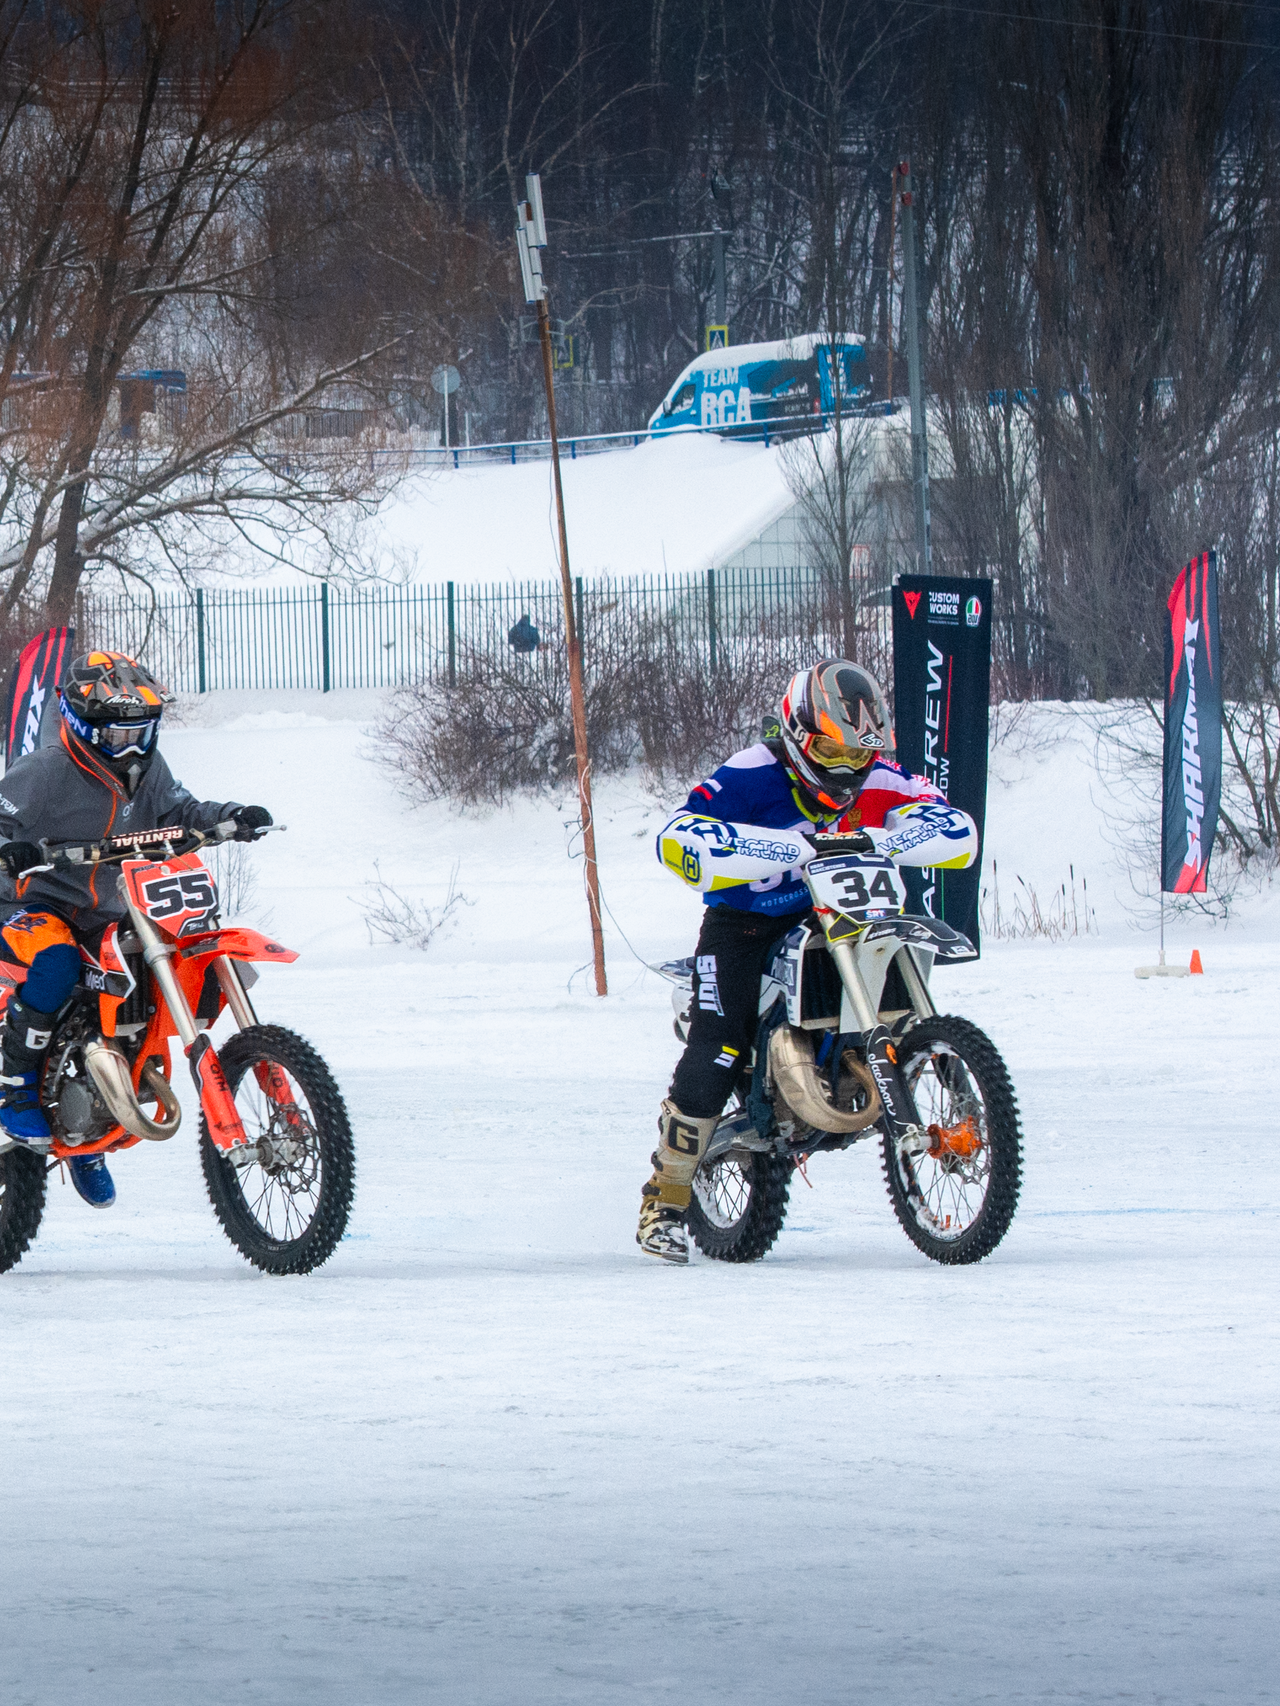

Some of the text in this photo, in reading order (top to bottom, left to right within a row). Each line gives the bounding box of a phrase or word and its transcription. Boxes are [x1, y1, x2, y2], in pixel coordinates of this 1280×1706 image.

[704, 367, 738, 388] TEAM
[929, 603, 958, 615] WORKS
[112, 828, 184, 848] RENTHAL
[140, 871, 218, 921] 55
[761, 887, 809, 908] MOTOCROSS
[830, 869, 899, 909] 34
[867, 1053, 897, 1117] Jackson
